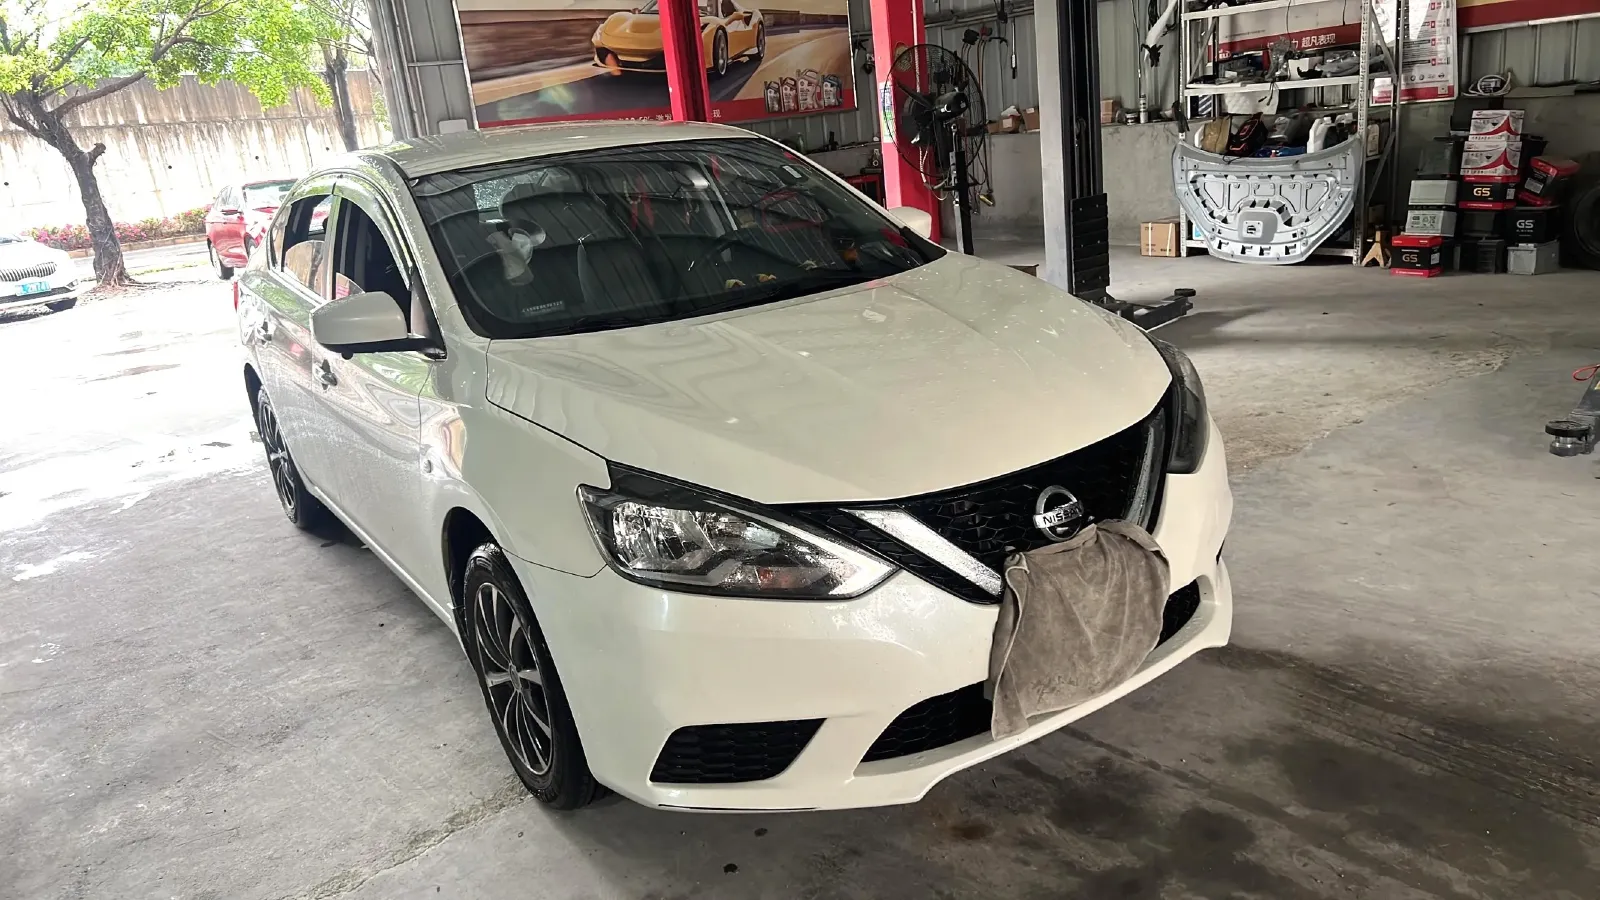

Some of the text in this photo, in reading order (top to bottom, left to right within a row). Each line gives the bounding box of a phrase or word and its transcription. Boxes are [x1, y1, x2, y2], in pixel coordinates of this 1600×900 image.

[1301, 33, 1336, 48] 超凡表现
[1473, 187, 1491, 197] GS
[1516, 219, 1534, 229] GS
[1402, 253, 1418, 263] GS
